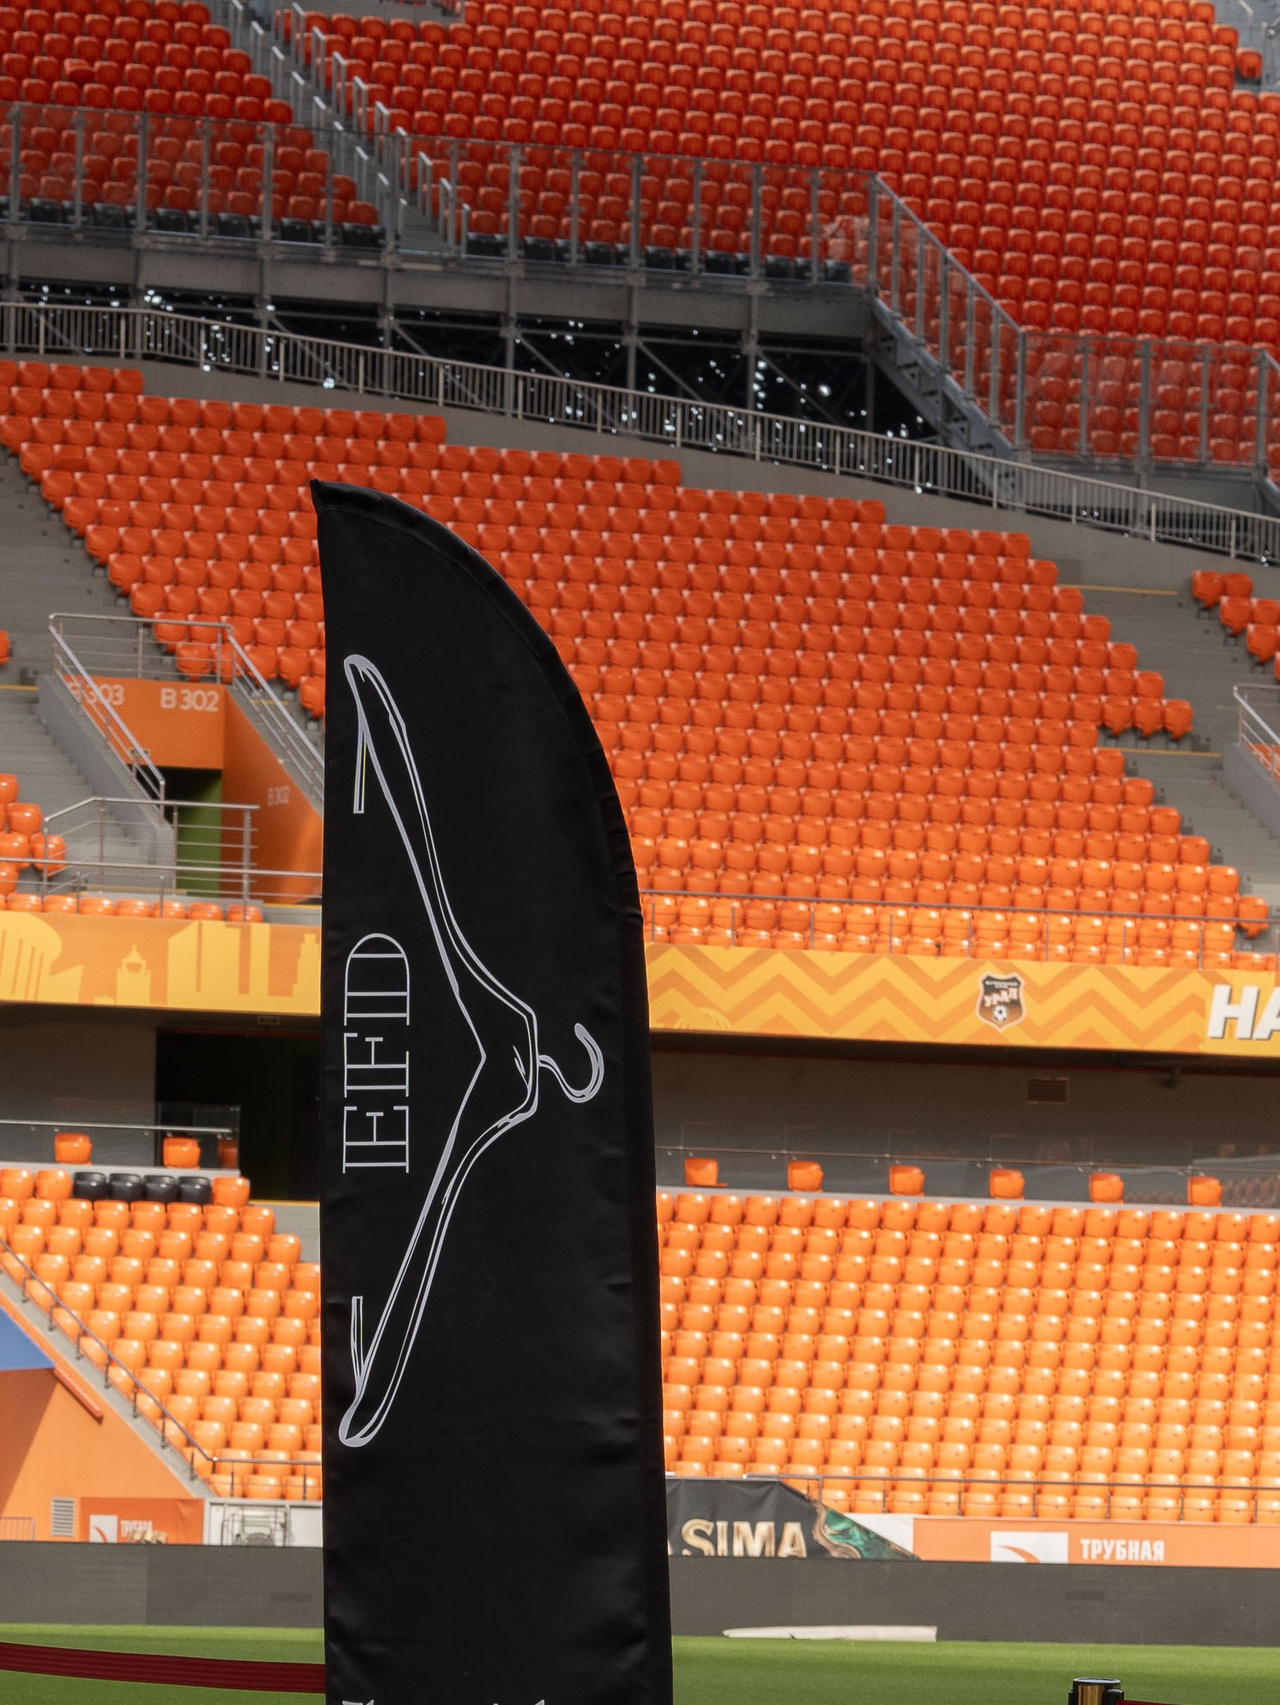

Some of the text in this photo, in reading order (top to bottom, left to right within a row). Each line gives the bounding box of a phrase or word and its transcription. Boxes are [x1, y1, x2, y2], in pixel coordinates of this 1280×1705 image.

[180, 688, 219, 712] 302
[342, 933, 410, 1173] EFD
[681, 1518, 807, 1558] SIMA
[1080, 1538, 1165, 1561] ТРУБНАЯ
